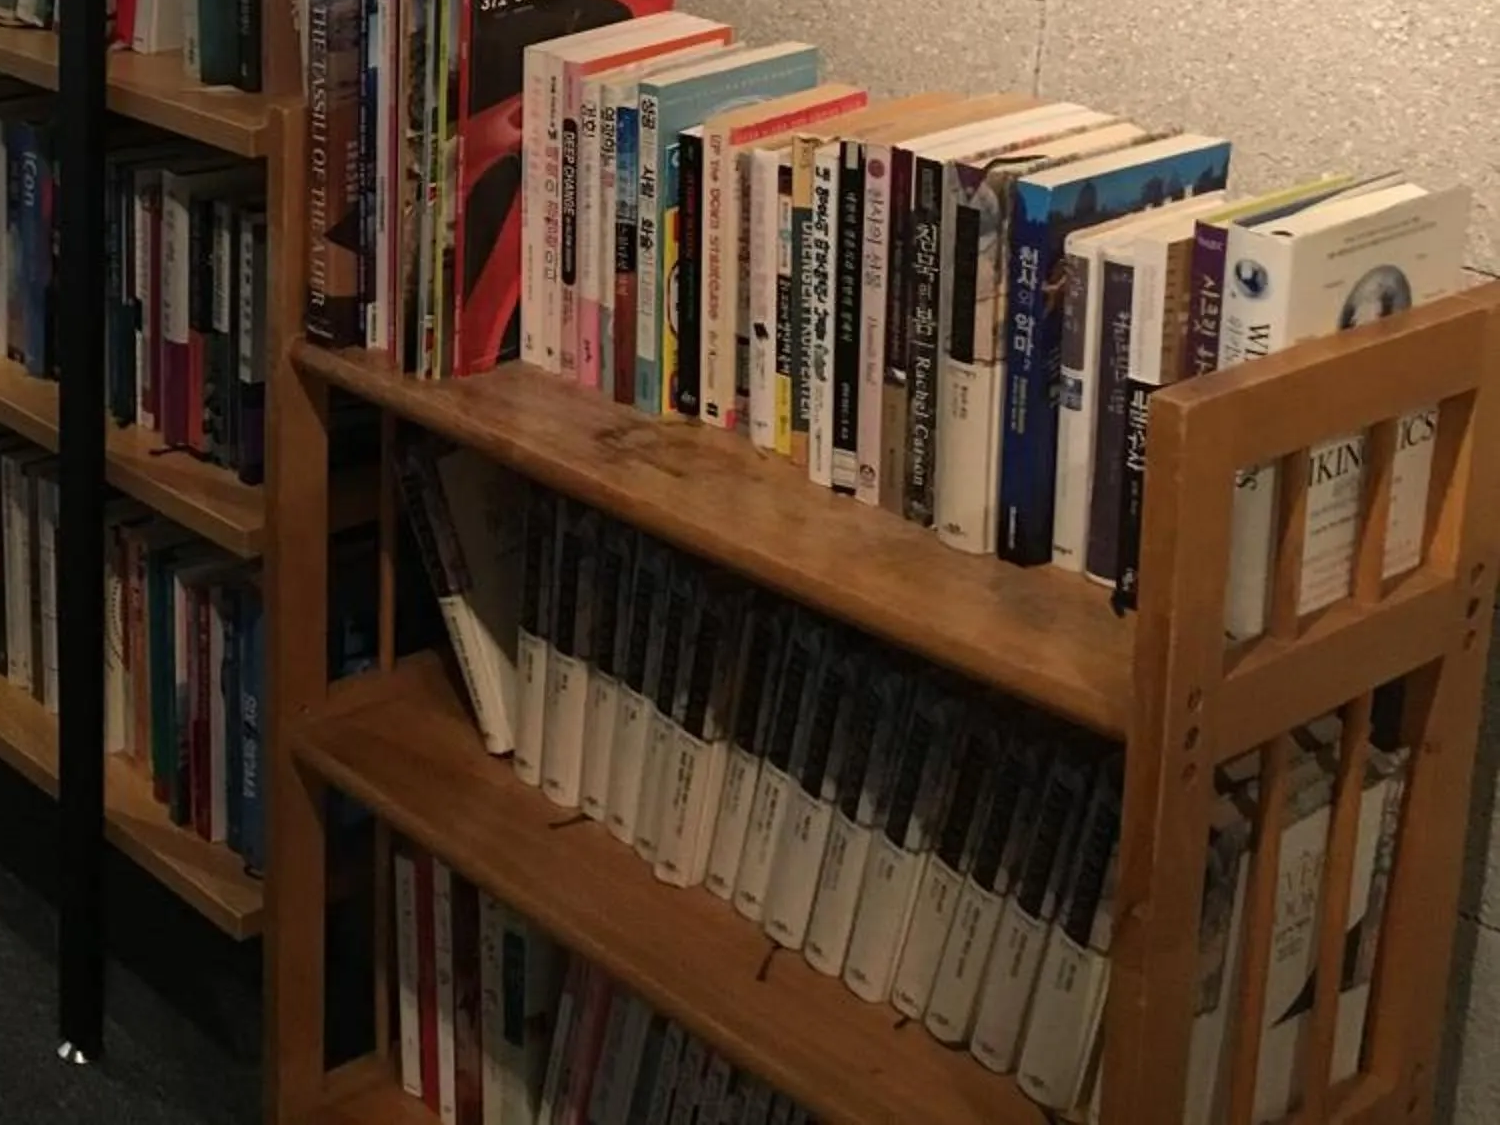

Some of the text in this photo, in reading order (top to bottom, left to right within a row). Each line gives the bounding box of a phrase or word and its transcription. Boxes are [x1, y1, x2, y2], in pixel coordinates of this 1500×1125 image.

[310, 6, 327, 52] THE
[310, 147, 327, 180] OF
[563, 131, 576, 164] DEEP
[309, 185, 326, 231] THE
[563, 165, 576, 216] CHANGE
[1193, 273, 1222, 337] 시크릿
[912, 356, 930, 487] Rachel Carson
